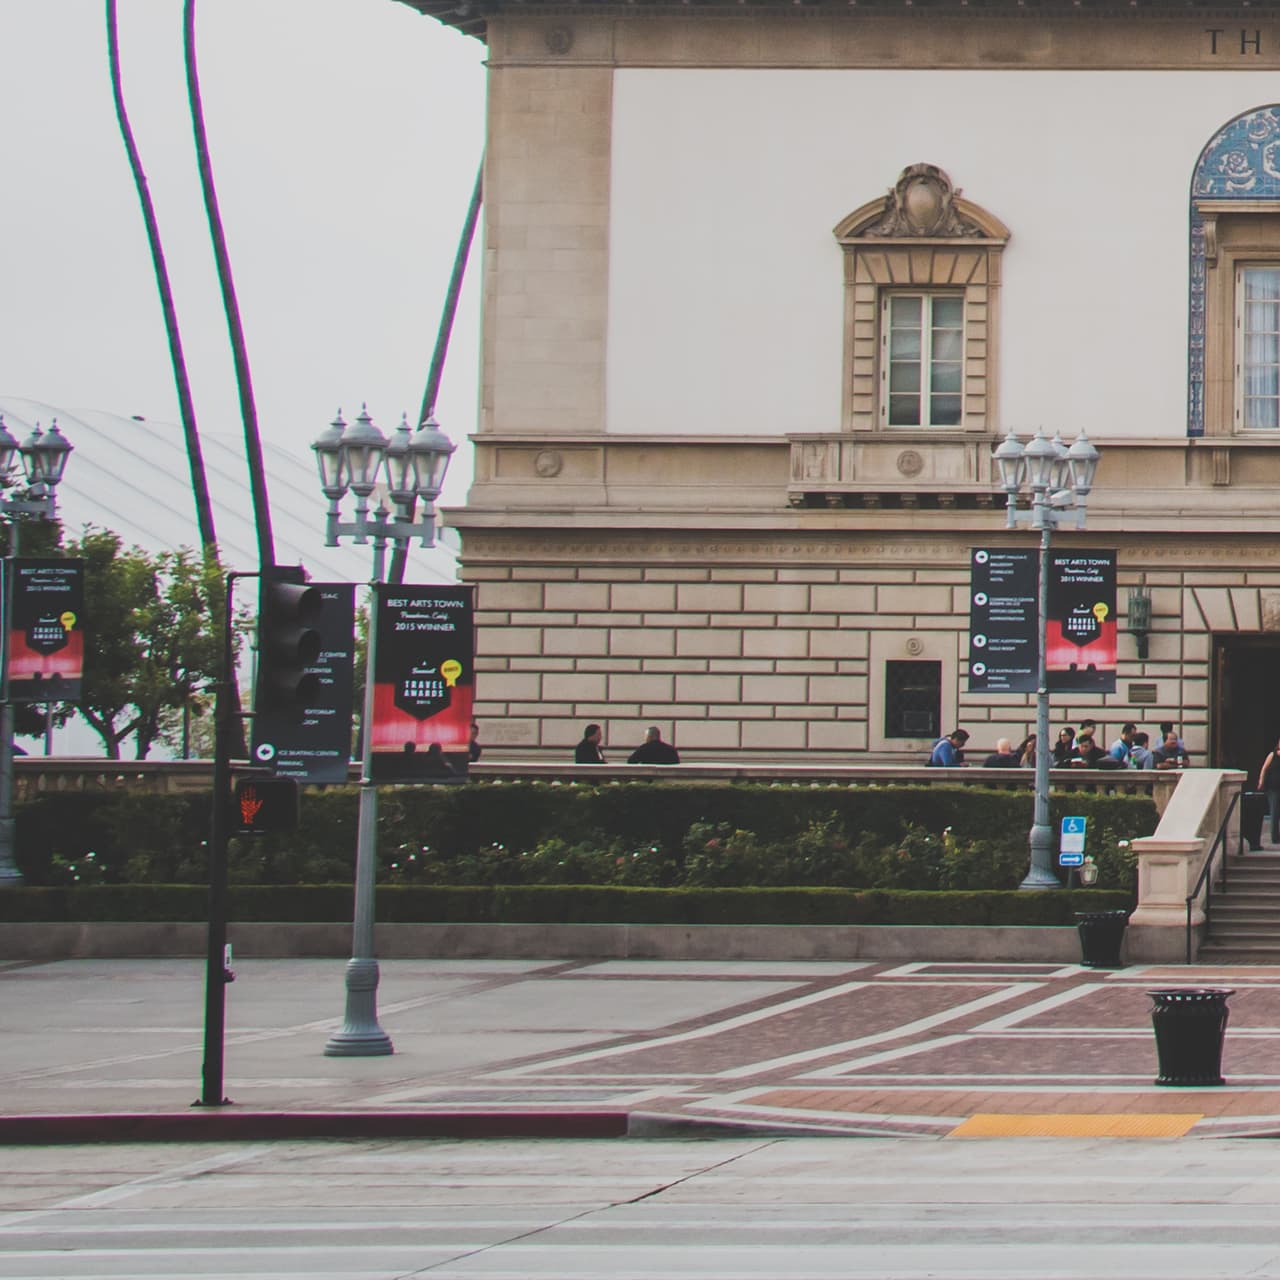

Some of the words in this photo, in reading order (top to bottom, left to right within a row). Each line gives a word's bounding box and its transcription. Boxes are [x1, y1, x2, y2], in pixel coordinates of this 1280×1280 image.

[1054, 558, 1070, 566] BEST
[1076, 575, 1104, 583] WINNER
[387, 599, 408, 607] BEST
[409, 600, 432, 608] ARTS
[433, 600, 465, 608] TOWN
[395, 622, 416, 631] 2015
[416, 623, 456, 631] WINNER
[404, 680, 444, 689] TRAVEL
[403, 689, 444, 697] AWARDS
